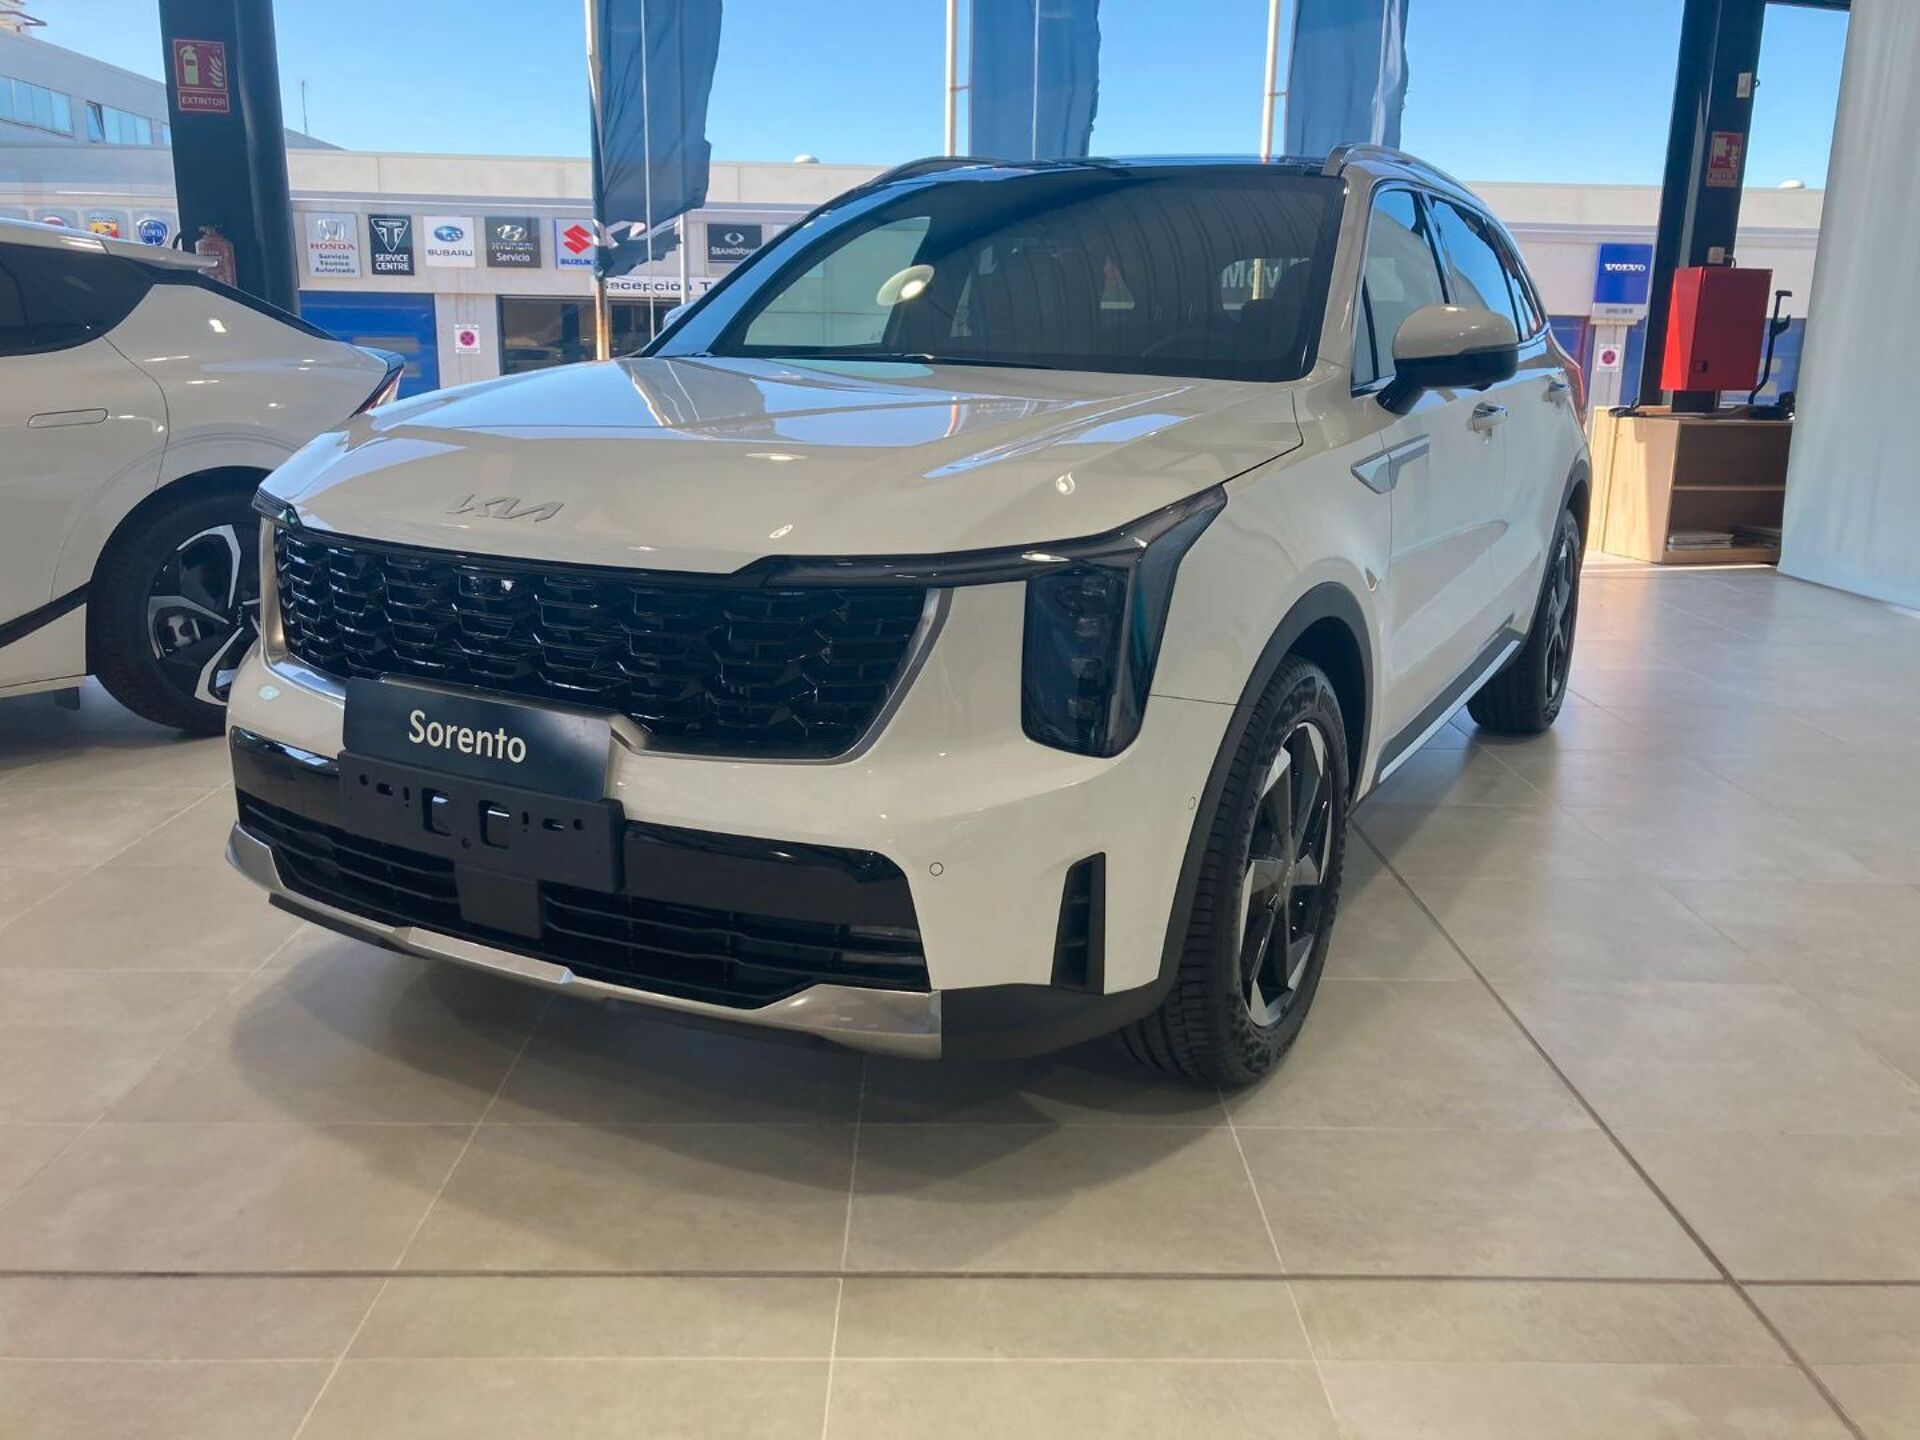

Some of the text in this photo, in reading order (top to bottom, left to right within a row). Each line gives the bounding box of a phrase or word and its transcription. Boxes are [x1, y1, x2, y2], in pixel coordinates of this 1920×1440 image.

[318, 252, 350, 260] Servicio
[427, 248, 473, 257] SUBARU
[496, 252, 531, 262] Servicio
[375, 253, 409, 262] SERVICE
[560, 258, 594, 266] SUZUK
[315, 266, 356, 274] Autorizado
[375, 262, 410, 271] CENTRE
[1604, 263, 1646, 271] VOLVO
[446, 493, 565, 523] KIA
[408, 709, 527, 764] Sorento
